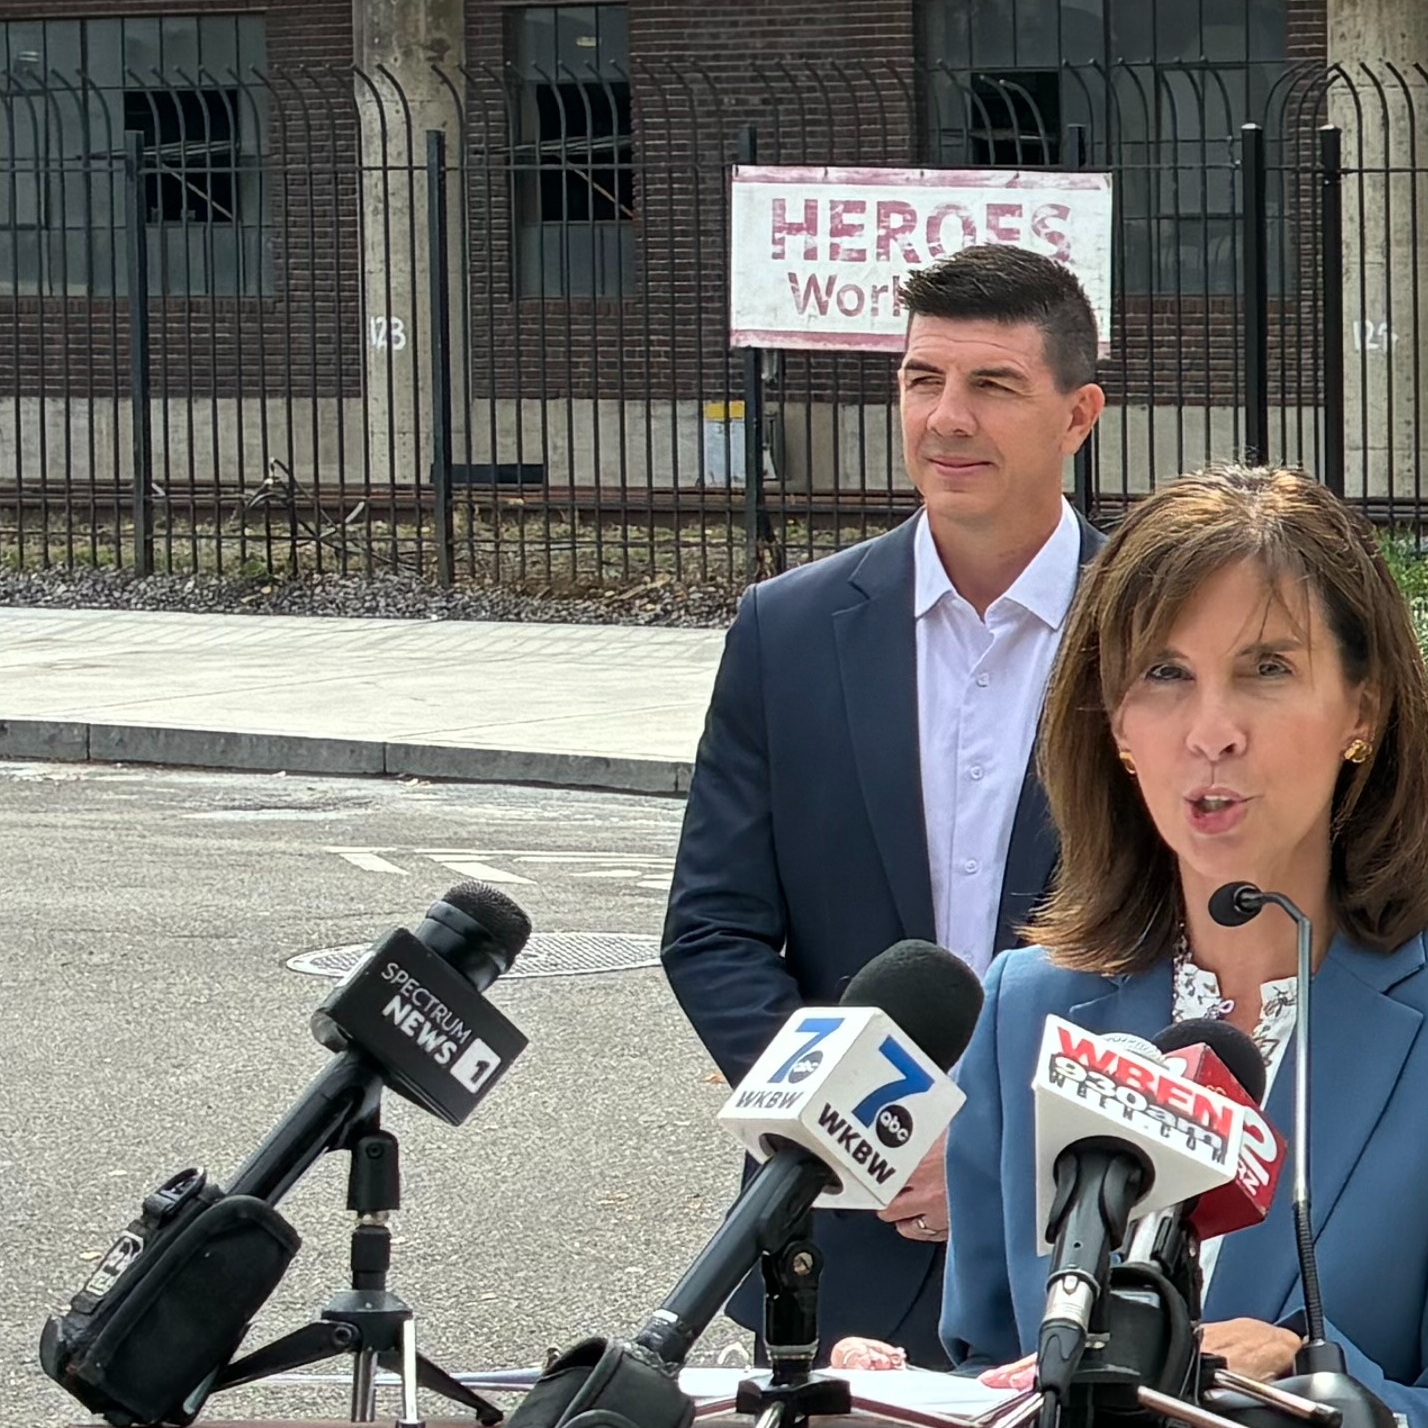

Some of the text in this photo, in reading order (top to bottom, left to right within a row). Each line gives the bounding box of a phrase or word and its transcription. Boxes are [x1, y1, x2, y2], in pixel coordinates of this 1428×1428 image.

[770, 198, 1072, 263] HEROES
[787, 271, 902, 318] Wor
[381, 962, 472, 1045] SPECTRUM
[381, 994, 490, 1084] NEWS 1
[767, 1017, 846, 1084] 7
[851, 1034, 936, 1129] 7
[1057, 1025, 1234, 1138] WBEN
[735, 1090, 804, 1109] WKBW
[879, 1110, 909, 1142] abc
[817, 1102, 897, 1185] WKBW
